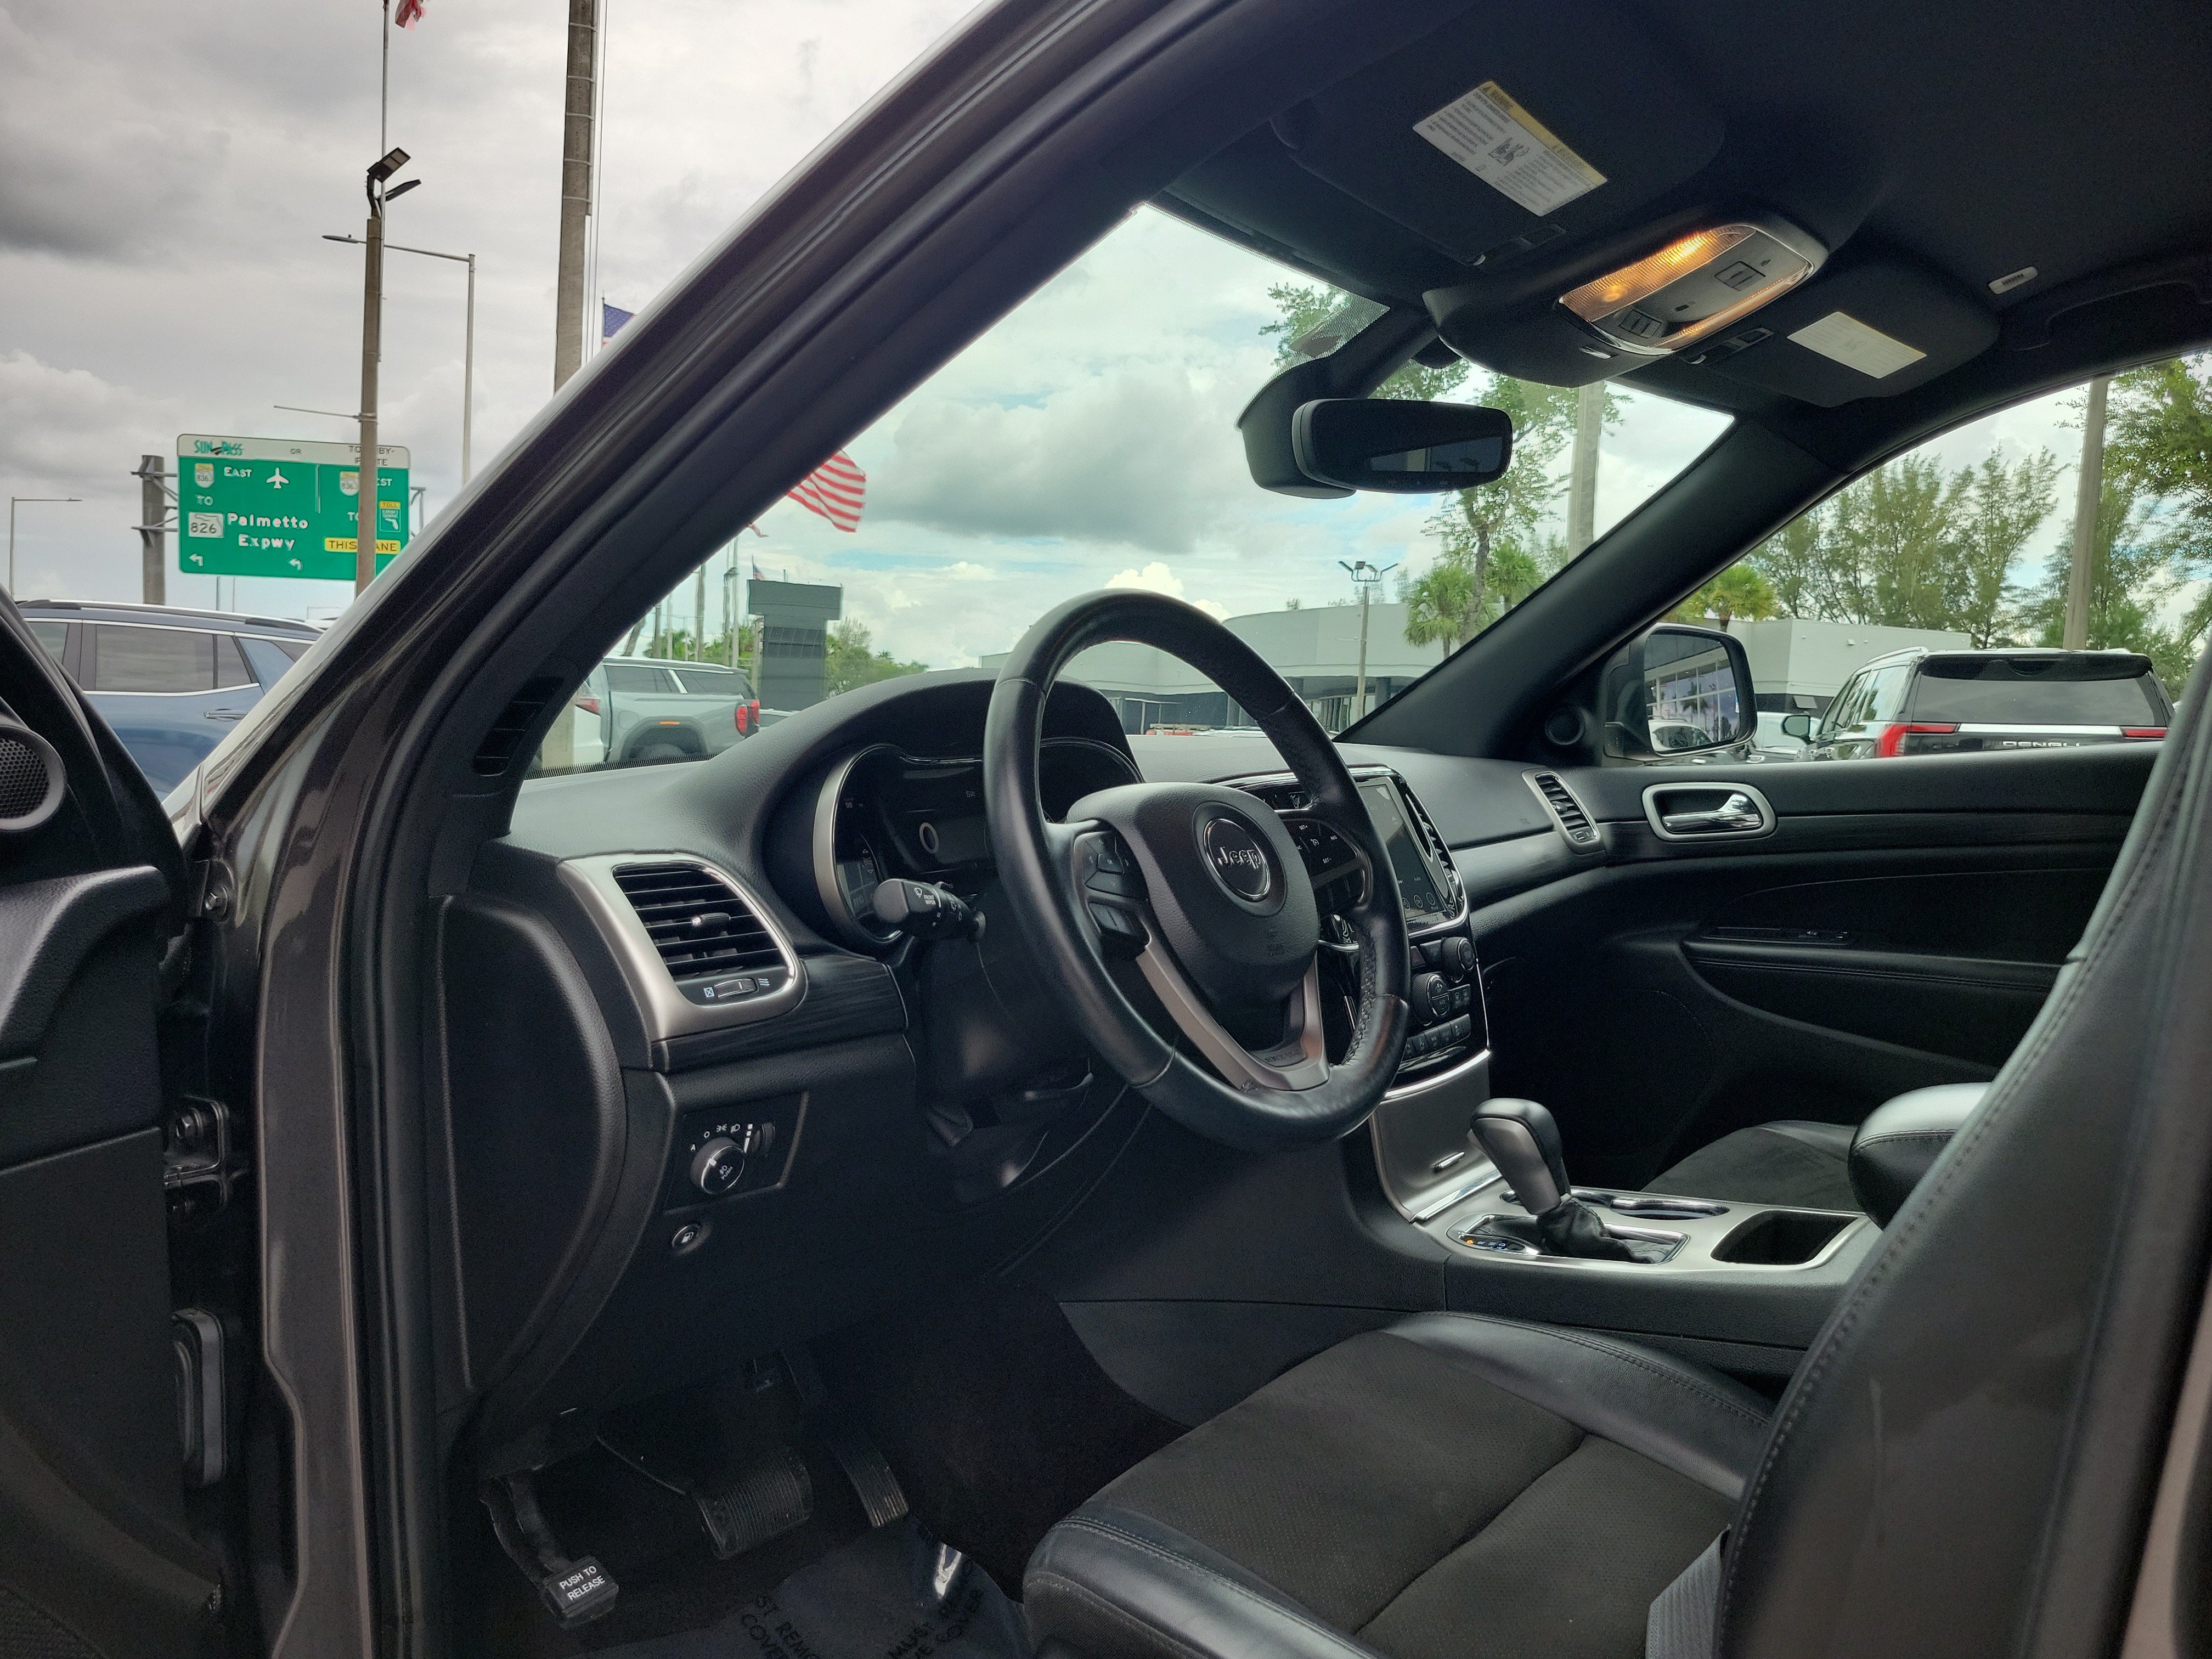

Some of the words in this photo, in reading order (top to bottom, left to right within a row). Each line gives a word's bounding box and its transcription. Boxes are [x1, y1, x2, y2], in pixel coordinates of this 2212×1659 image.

[224, 466, 252, 477] EAST
[197, 495, 214, 506] TO
[190, 522, 217, 534] 826
[227, 513, 309, 529] Palmetto
[238, 534, 295, 550] Expwy
[329, 540, 358, 550] THIS
[376, 542, 397, 552] ANE
[1218, 847, 1261, 870] Jeep
[559, 1572, 584, 1590] PUSH
[583, 1566, 597, 1576] TO
[567, 1575, 606, 1601] RELEASE
